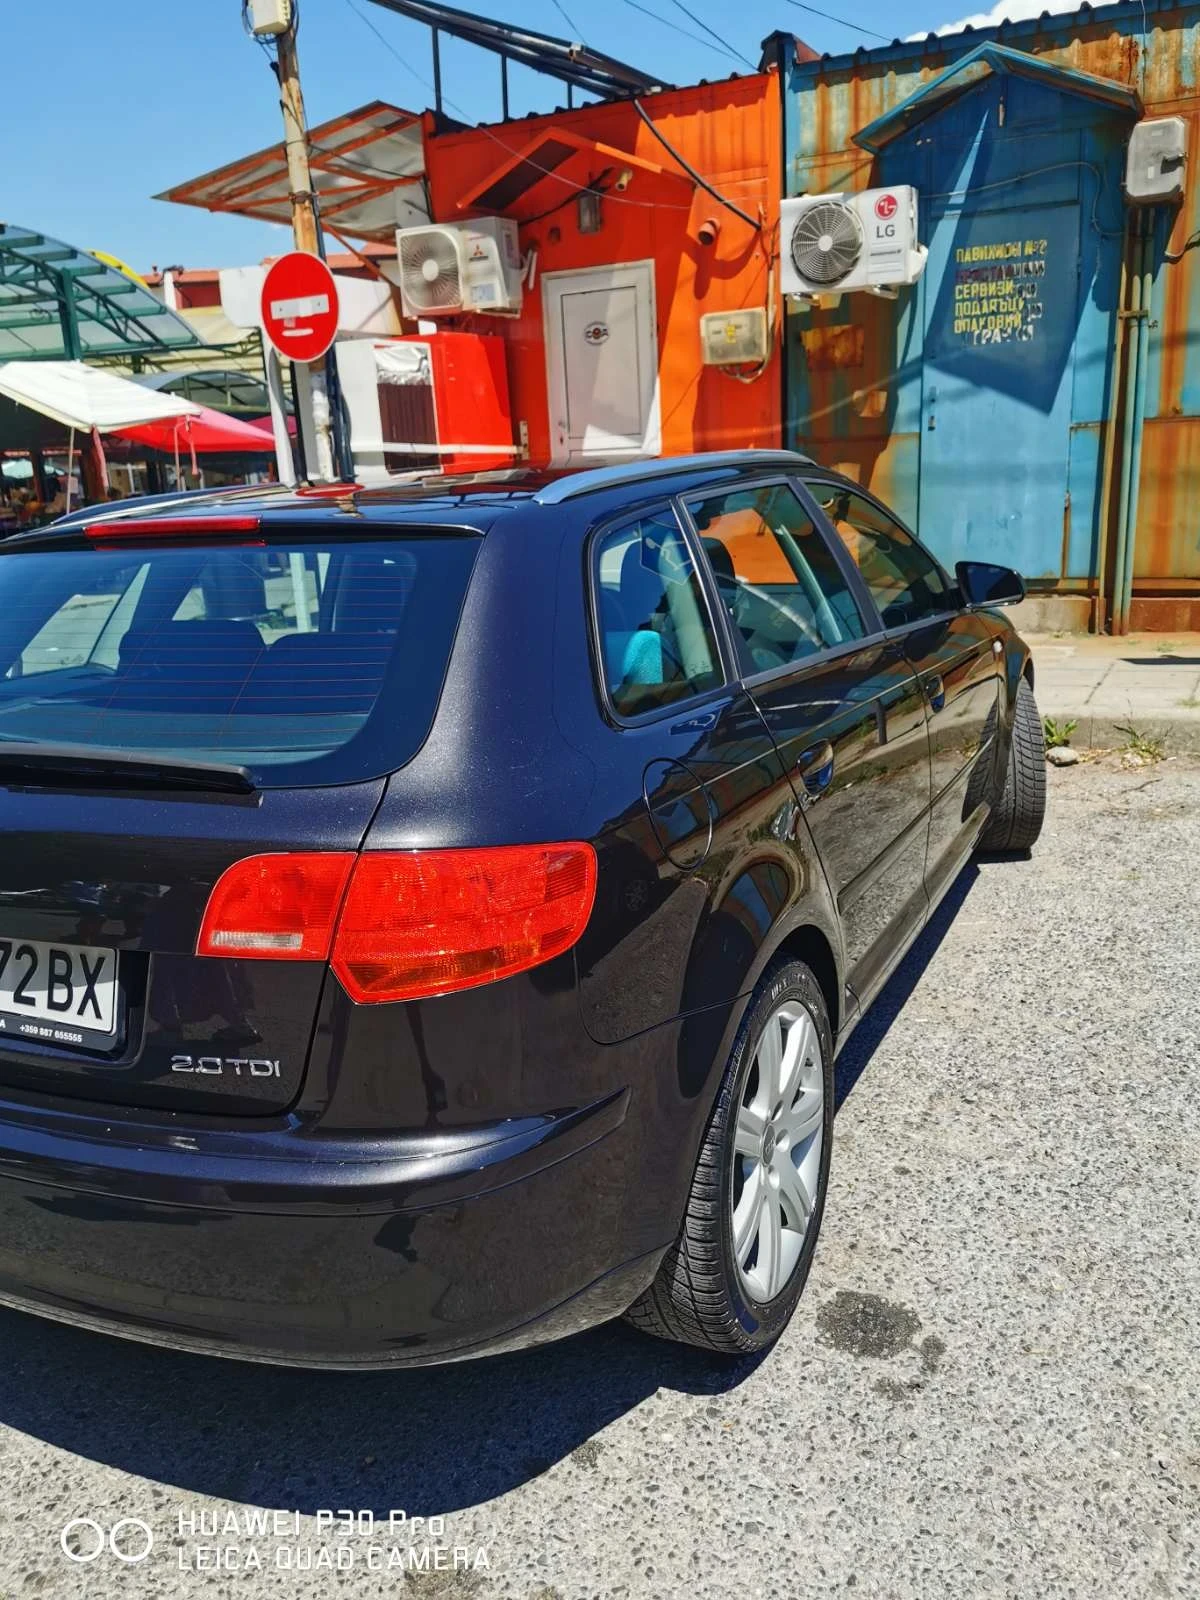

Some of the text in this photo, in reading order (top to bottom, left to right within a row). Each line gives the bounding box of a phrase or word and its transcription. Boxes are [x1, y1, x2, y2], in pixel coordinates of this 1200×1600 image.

[876, 225, 896, 239] LG
[20, 1024, 39, 1034] +359
[171, 1055, 281, 1077] 2.0 TDI
